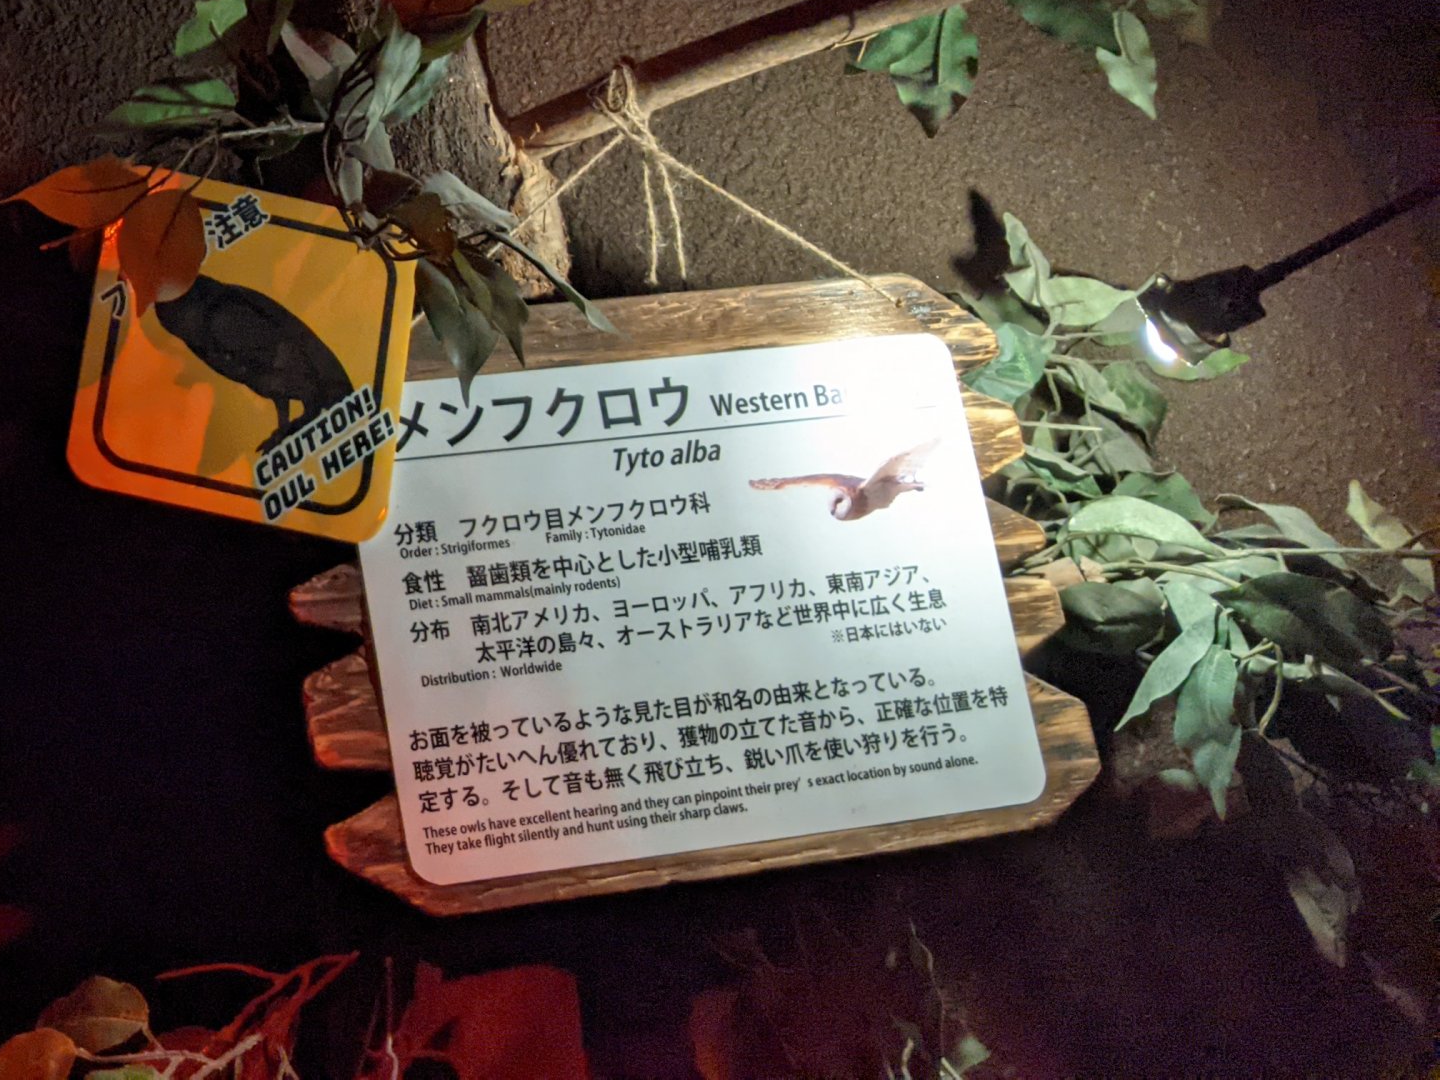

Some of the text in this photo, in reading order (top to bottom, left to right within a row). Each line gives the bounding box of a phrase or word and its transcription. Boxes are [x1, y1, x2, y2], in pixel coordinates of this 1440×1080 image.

[255, 386, 374, 487] CAUTION!
[395, 376, 688, 452] メンフクロウ
[709, 391, 808, 416] Western
[321, 411, 395, 481] HERE!
[612, 439, 720, 476] Tyto alba
[393, 491, 710, 546] 分類 フクロウ目メンフクロウ科
[440, 538, 510, 555] Strigiformes
[589, 522, 645, 540] Tytonidae
[401, 568, 446, 595] 食性
[440, 592, 473, 607] Small
[573, 575, 620, 591] rodents)
[409, 618, 450, 643] 分布
[475, 588, 946, 663] 太平洋の島々、オーストラリアなど世界中に広く生息
[499, 659, 562, 677] Worldwide
[409, 667, 933, 751] お面を被っているような見た目が和名の由来となっている。
[412, 685, 1007, 782] 聴覚がたいへん優れており、獲物の立てた音から、正確な位置を特
[418, 722, 965, 813] 定する。そして音も無く飛び立ち、鋭い爪を使い狩りを行う。
[422, 825, 457, 839] These
[459, 819, 486, 834] owls
[487, 817, 516, 830] have
[518, 809, 571, 826] excellent
[572, 803, 618, 818] hearing
[620, 797, 642, 812] and
[643, 796, 669, 809] they
[671, 794, 692, 805] can
[693, 786, 743, 805] pinpoint
[744, 781, 771, 795] their
[814, 772, 845, 786] exact
[846, 766, 891, 781] location
[892, 763, 906, 777] by
[908, 757, 943, 773] sound
[944, 755, 978, 768] alone.
[424, 802, 747, 855] They take flight silently and hunt using their sharp claws.
